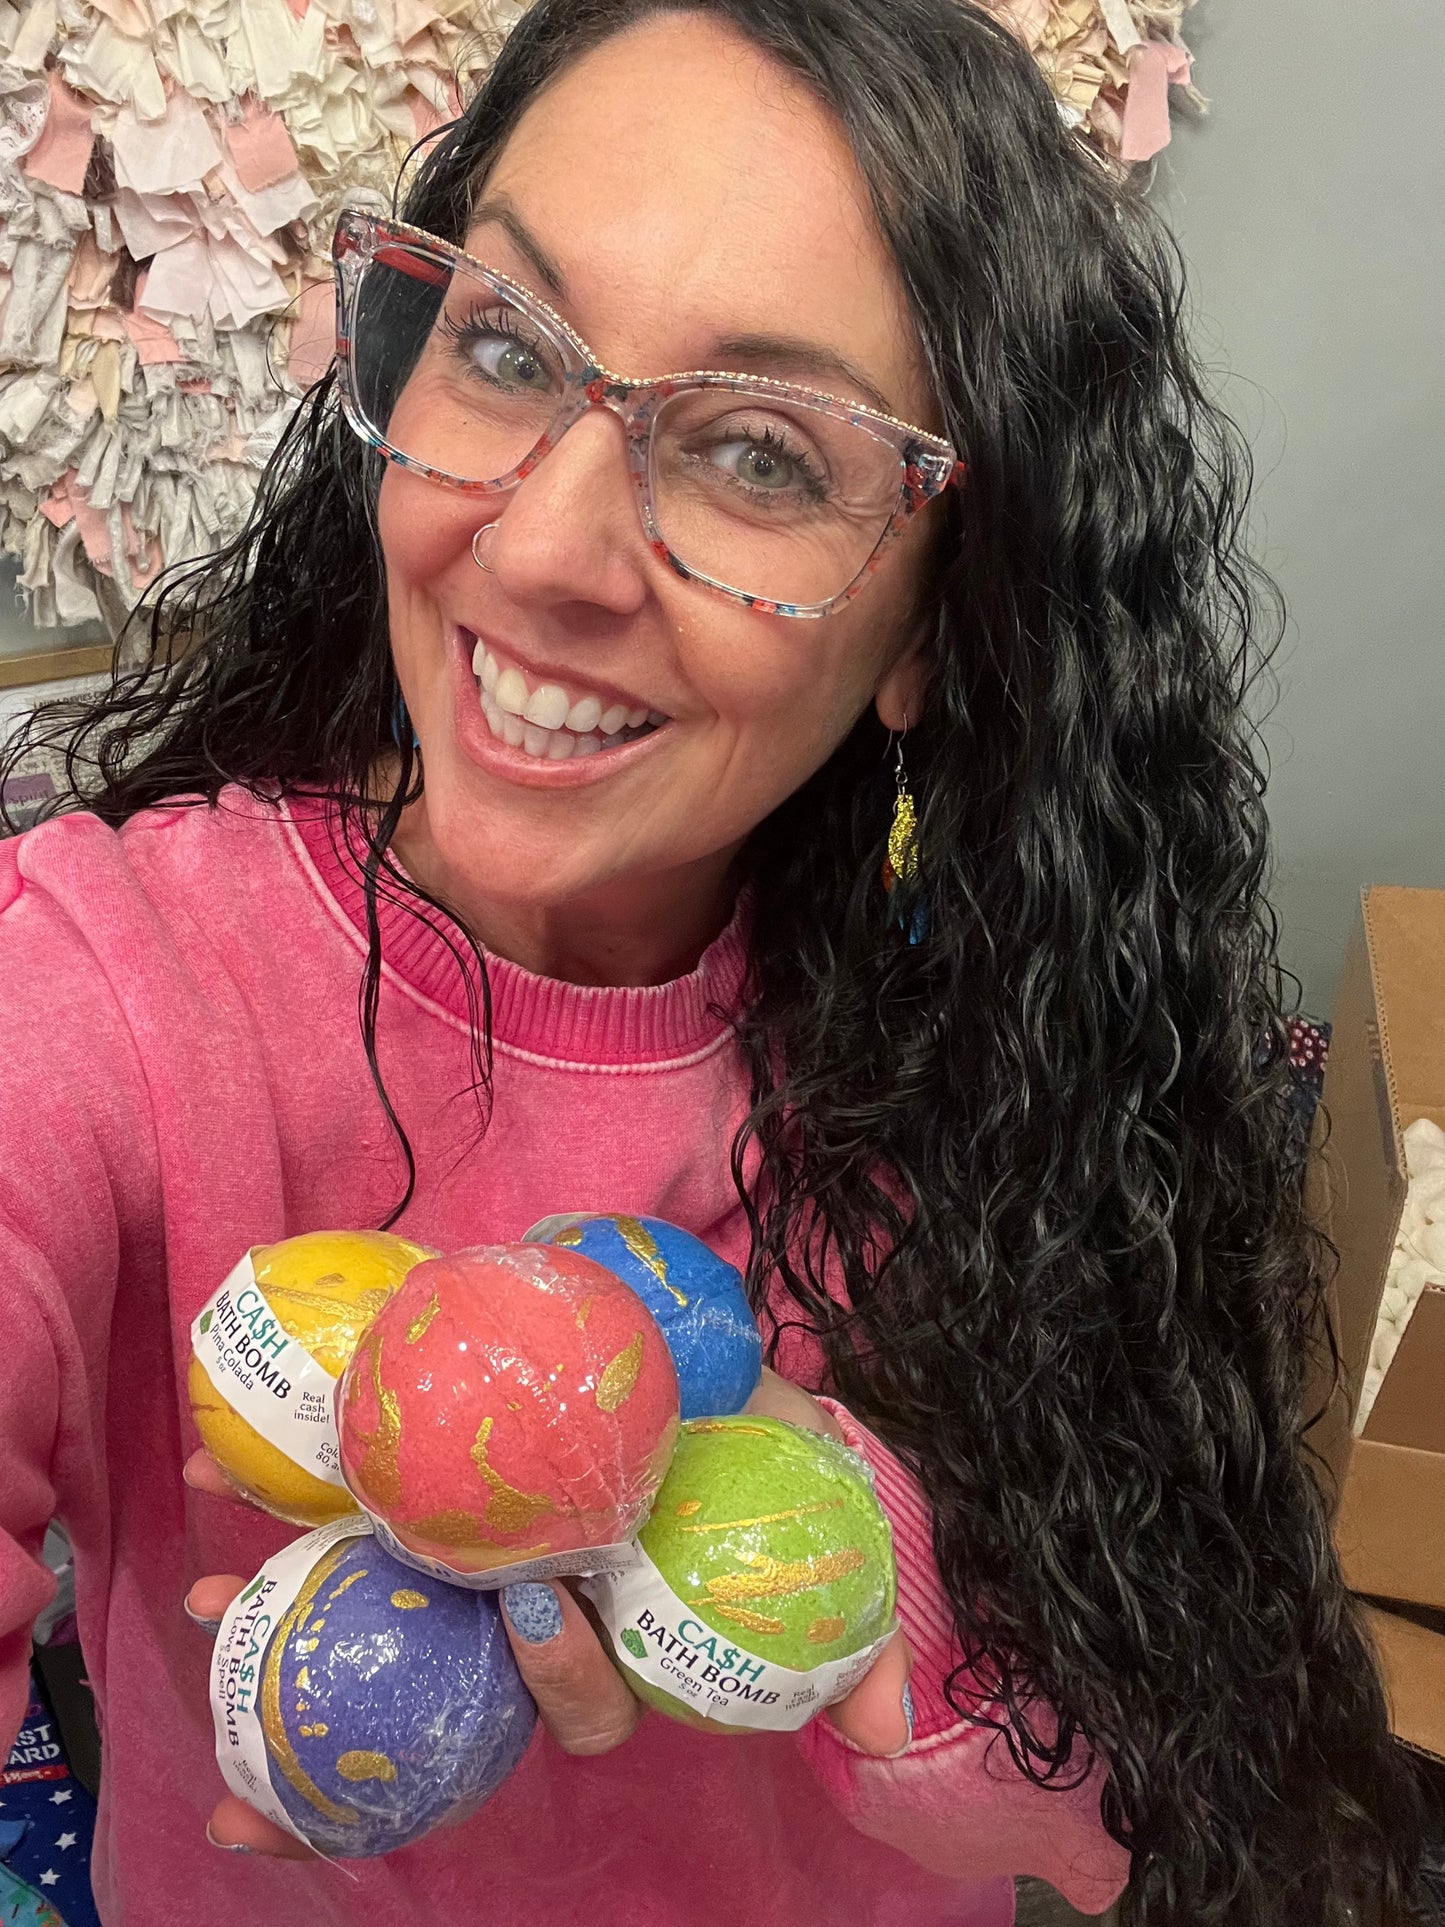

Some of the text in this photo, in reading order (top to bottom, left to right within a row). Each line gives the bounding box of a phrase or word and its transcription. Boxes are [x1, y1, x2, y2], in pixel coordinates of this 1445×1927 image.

[215, 1290, 293, 1400] BATH BOMB
[236, 1289, 289, 1359] CA$H
[210, 1323, 254, 1391] Pina Colada
[219, 1363, 227, 1374] oz
[293, 1410, 330, 1424] inside!
[299, 1403, 325, 1413] cash
[302, 1391, 326, 1404] Real
[218, 1616, 243, 1700] Love Spell
[226, 1580, 278, 1747] BATH BOMB
[236, 1615, 271, 1714] CA$H
[636, 1608, 699, 1670] BATH
[700, 1666, 780, 1706] BOMB
[677, 1619, 766, 1683] CA$H
[660, 1656, 730, 1707] Green Tea
[687, 1689, 698, 1698] oz
[5, 1743, 61, 1765] ARD
[15, 1723, 51, 1746] ST
